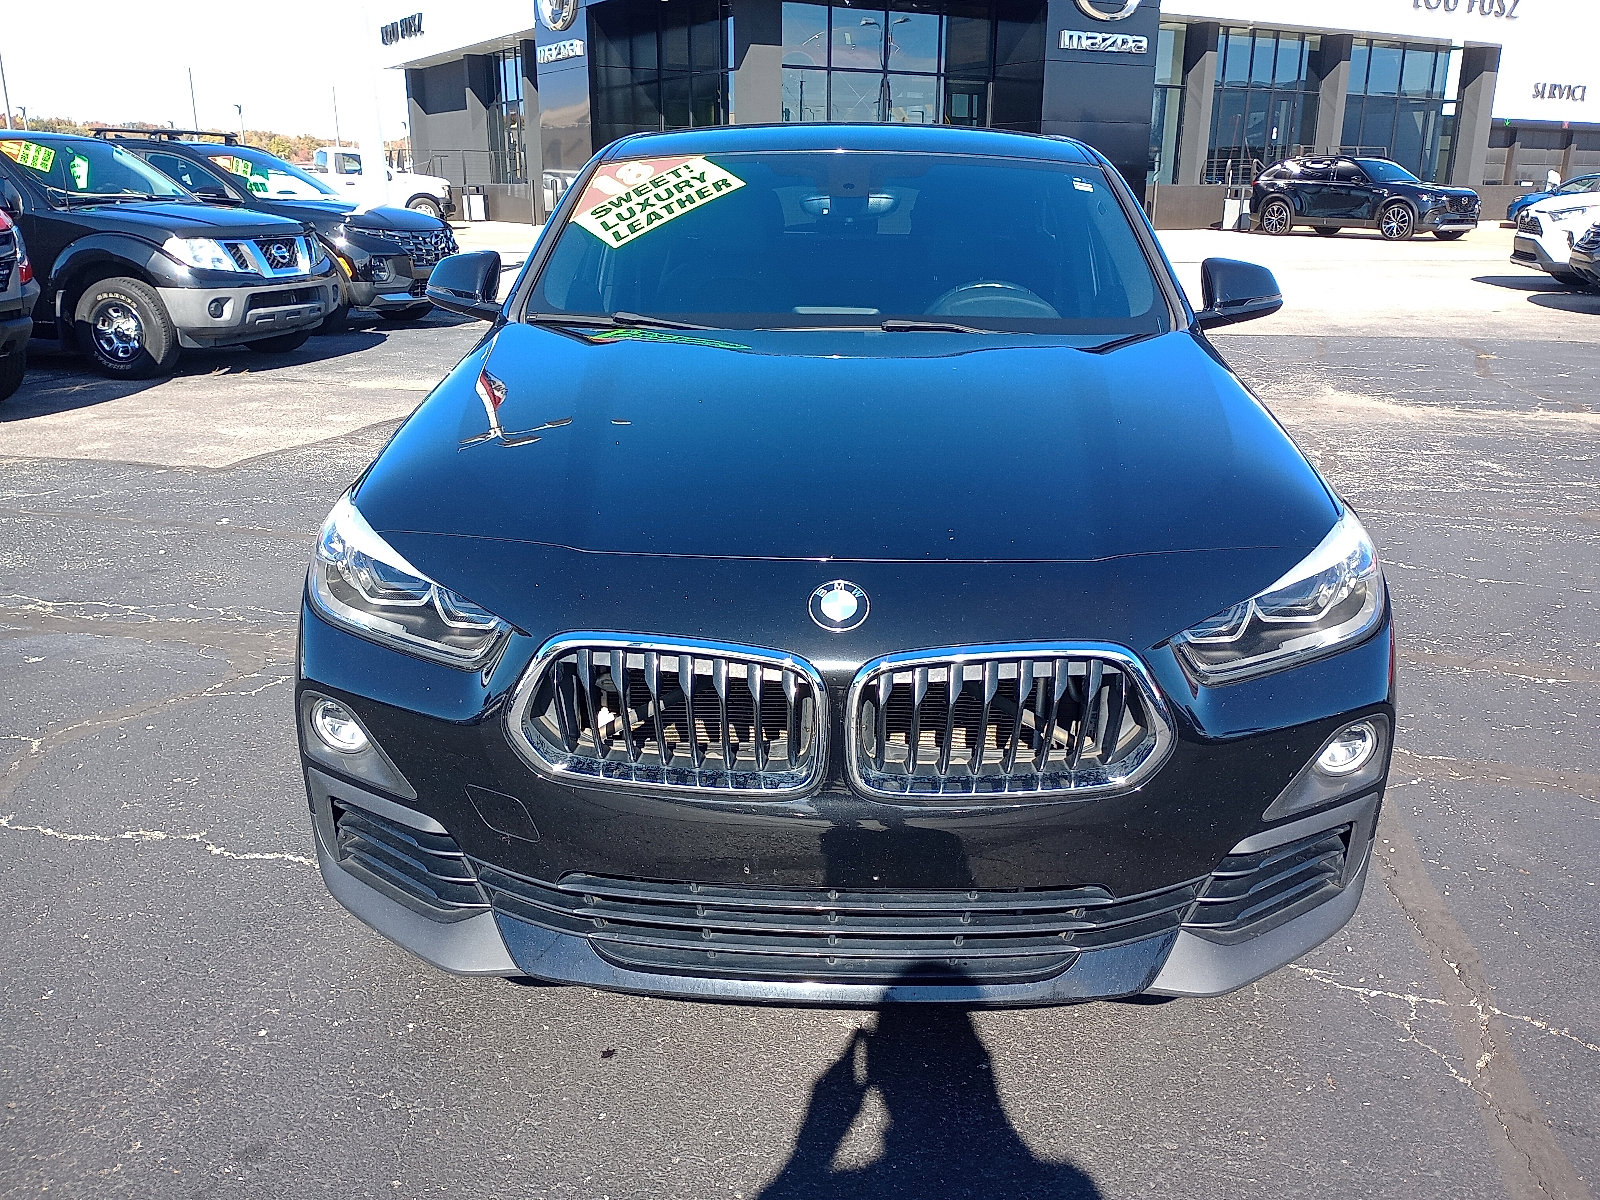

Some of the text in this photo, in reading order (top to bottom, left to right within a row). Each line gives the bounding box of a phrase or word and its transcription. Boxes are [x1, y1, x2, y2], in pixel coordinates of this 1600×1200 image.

[590, 164, 694, 219] SWEET!
[600, 171, 708, 231] LUXURY
[612, 178, 733, 242] LEATHER
[815, 582, 864, 598] BMW
